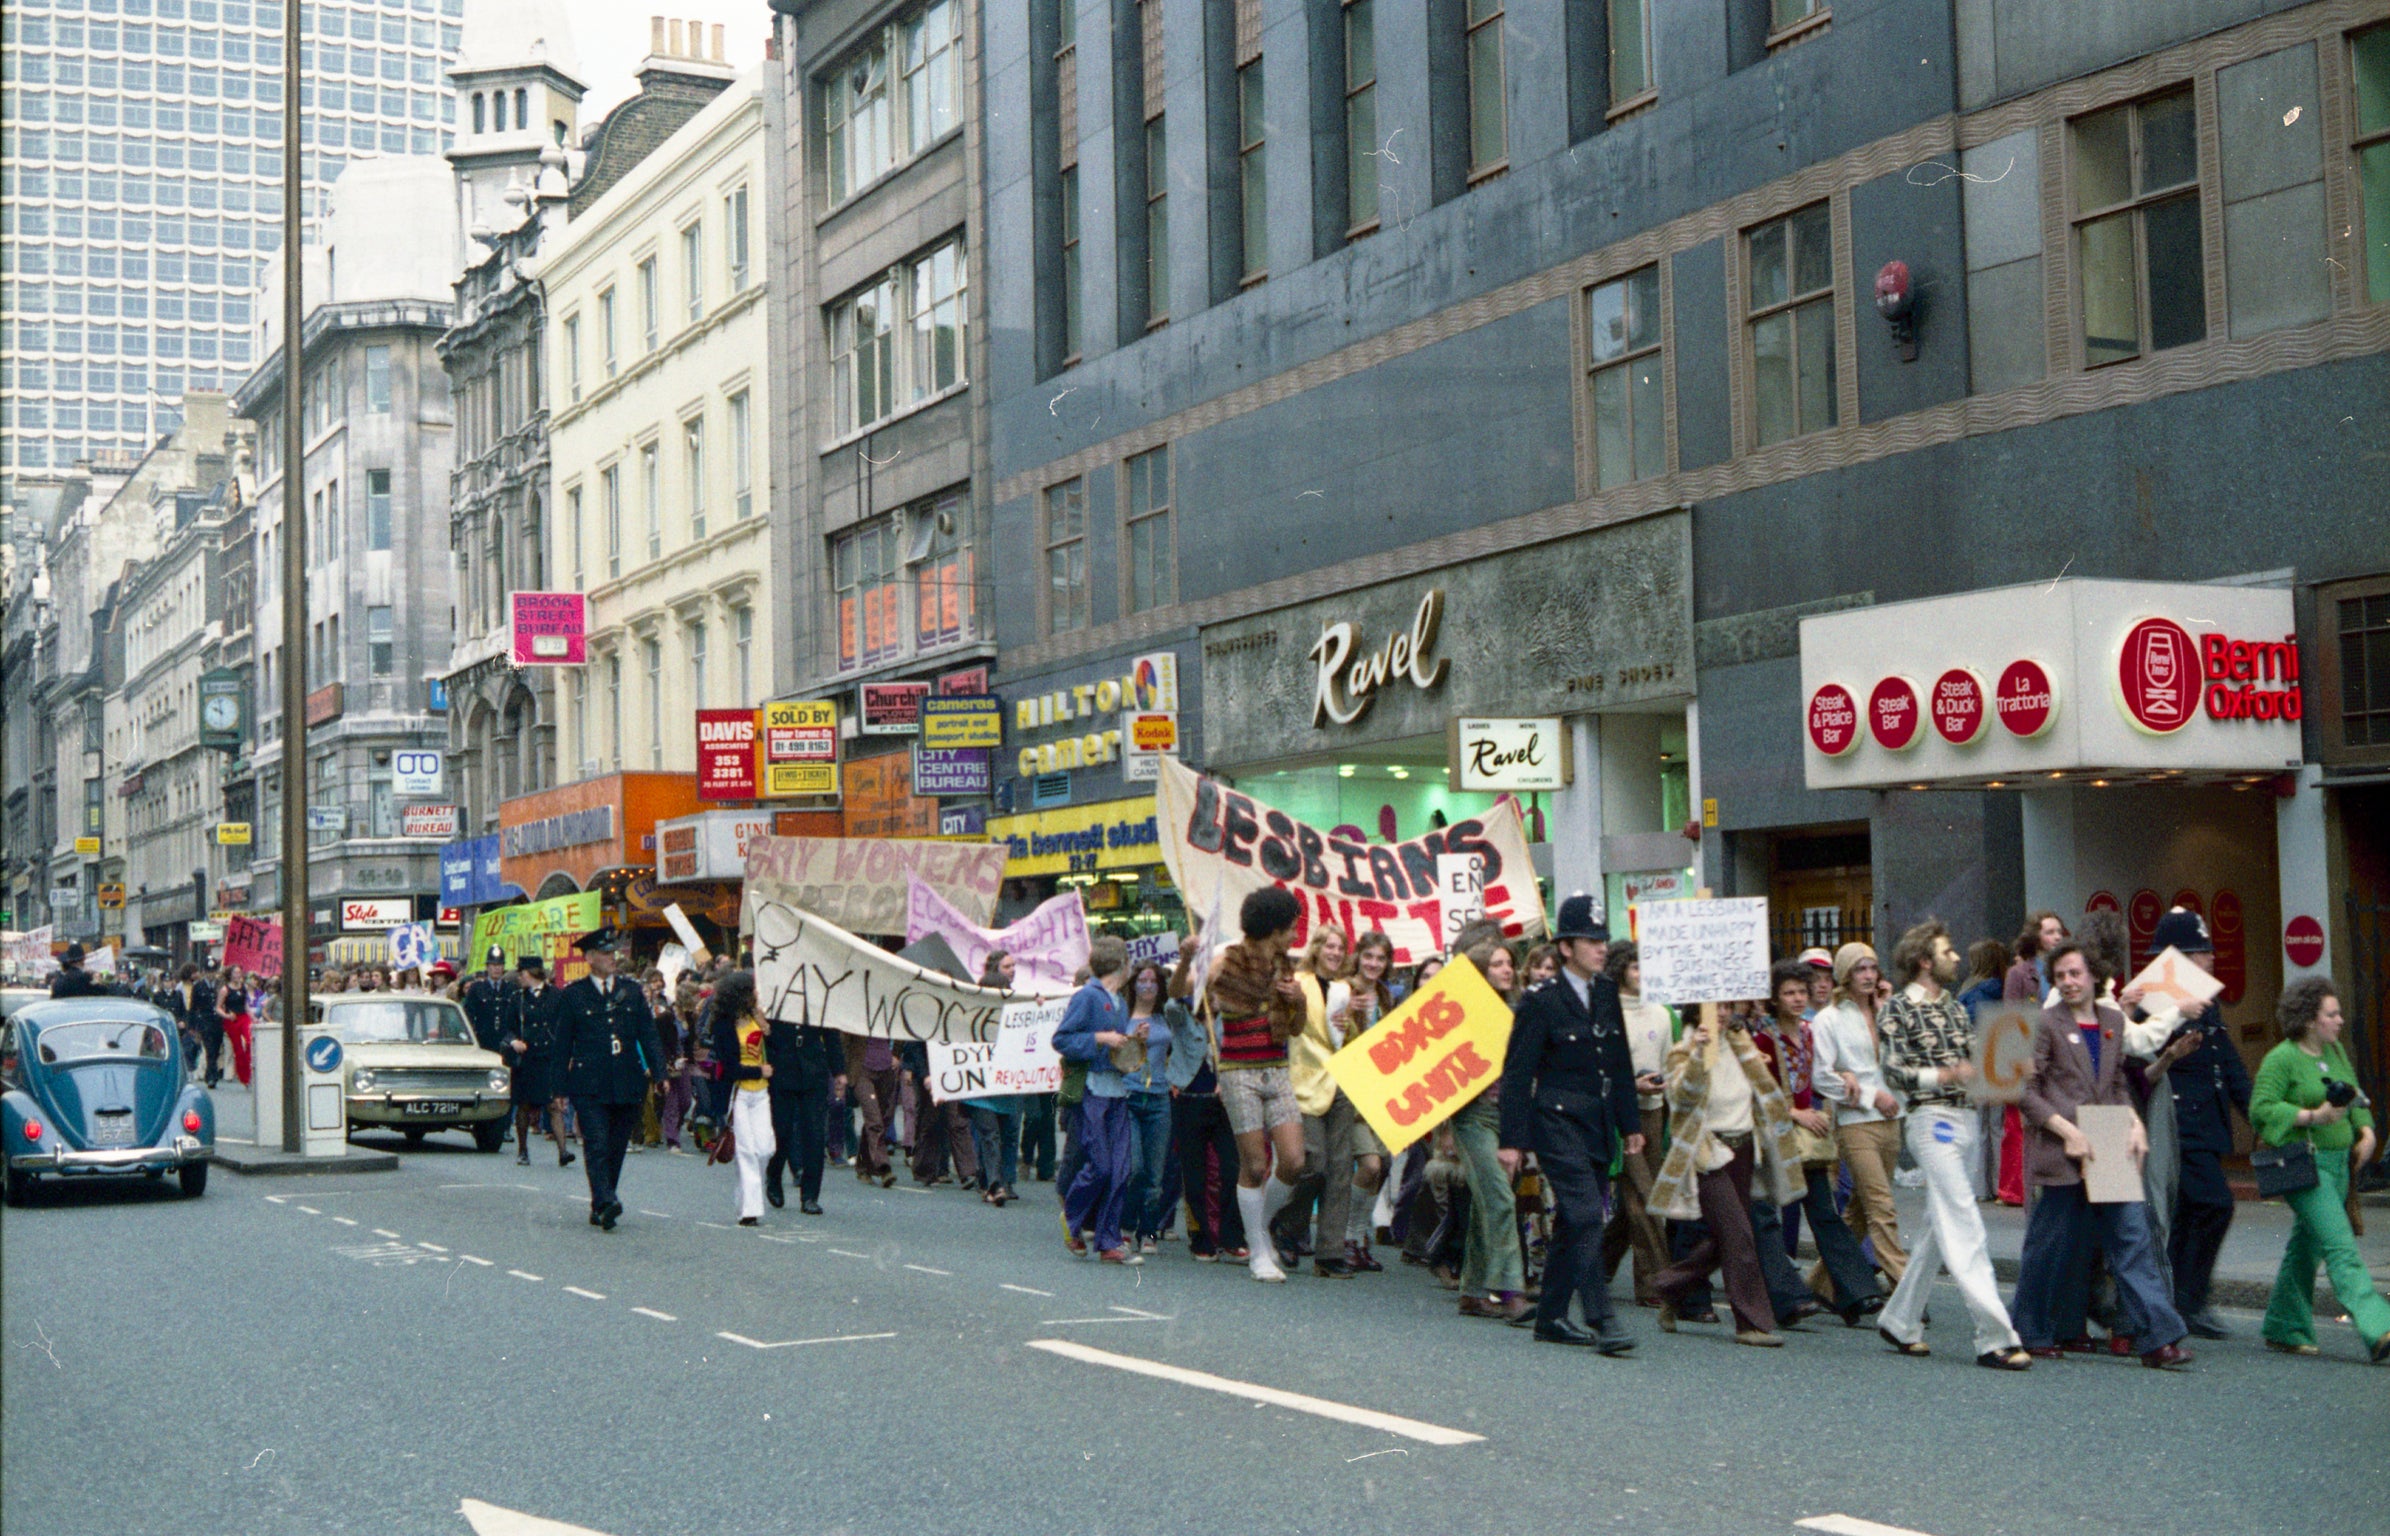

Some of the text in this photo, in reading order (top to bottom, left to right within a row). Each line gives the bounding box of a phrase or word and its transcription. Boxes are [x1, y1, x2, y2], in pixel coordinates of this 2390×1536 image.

[517, 596, 572, 608] BROOK
[517, 609, 576, 620] STREET
[517, 623, 582, 634] BUREAU
[1308, 589, 1451, 729] Ravel
[2150, 651, 2170, 665] Berni
[2203, 633, 2300, 681] Berni
[1940, 680, 1974, 698] Steak
[2015, 676, 2030, 692] La
[864, 687, 928, 707] Churchill
[926, 698, 997, 712] cameras
[1016, 675, 1136, 731] HILTON
[1815, 694, 1846, 712] Steak
[1877, 695, 1910, 714] Steak
[1936, 697, 1976, 715] & Duck
[1997, 692, 2050, 713] Trattoria
[2204, 683, 2302, 720] Oxford
[771, 710, 830, 725] SOLD BY
[935, 717, 989, 730] portrait and
[1812, 711, 1853, 728] & Plaice
[1882, 713, 1902, 730] Bar
[1945, 716, 1967, 732] Bar
[700, 721, 754, 741] DAVIS
[927, 731, 999, 743] passport studios
[1136, 726, 1172, 739] Kodak
[1823, 728, 1843, 744] Bar
[715, 755, 740, 766] 353
[919, 749, 958, 761] CITY
[1018, 730, 1122, 778] camer
[1469, 732, 1546, 777] Ravel
[713, 768, 743, 778] 3381
[919, 762, 987, 774] CENTRE
[919, 776, 988, 788] BUREAU
[1517, 776, 1553, 784] CHILDRENS
[403, 804, 457, 817] BURNETT
[406, 822, 453, 834] BUREAU
[942, 814, 966, 835] CITY
[1031, 823, 1105, 857] bennett
[1186, 775, 1503, 900] LESBIANS
[747, 834, 822, 881] GAY
[344, 904, 378, 925] Style
[1648, 901, 1667, 919] AM
[1688, 900, 1753, 917] LESBIAN
[484, 912, 518, 937] WE
[531, 902, 581, 931] ARE
[1646, 920, 1757, 941] MADE UNHAPPY
[1642, 940, 1753, 960] BY THE MUSIC
[1672, 955, 1754, 973] BUSINESS
[863, 969, 1000, 1045] WOME
[1025, 1032, 1037, 1047] IS
[1385, 1041, 1492, 1127] UNITE
[405, 1102, 460, 1114] ALC 721H
